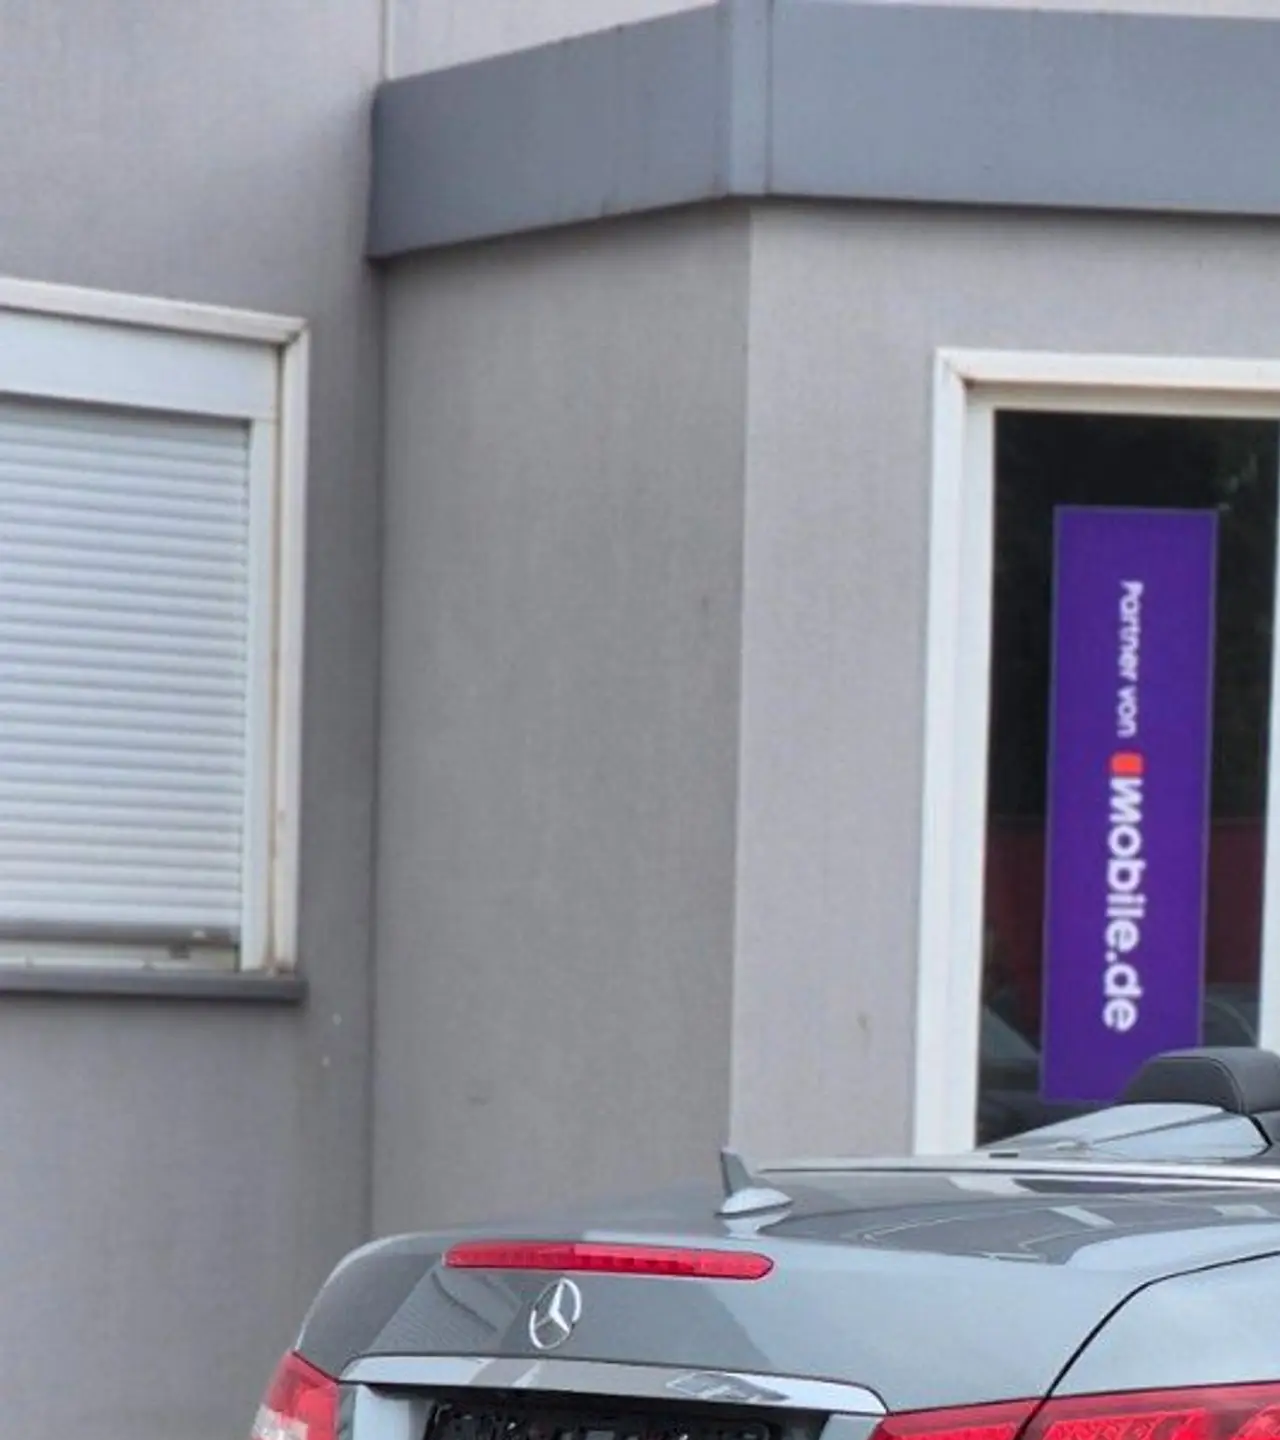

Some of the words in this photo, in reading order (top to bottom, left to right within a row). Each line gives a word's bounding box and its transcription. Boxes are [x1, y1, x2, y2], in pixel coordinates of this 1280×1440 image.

[1117, 580, 1144, 681] Partner
[1117, 685, 1138, 738] von
[1103, 776, 1147, 1032] mobile.de
